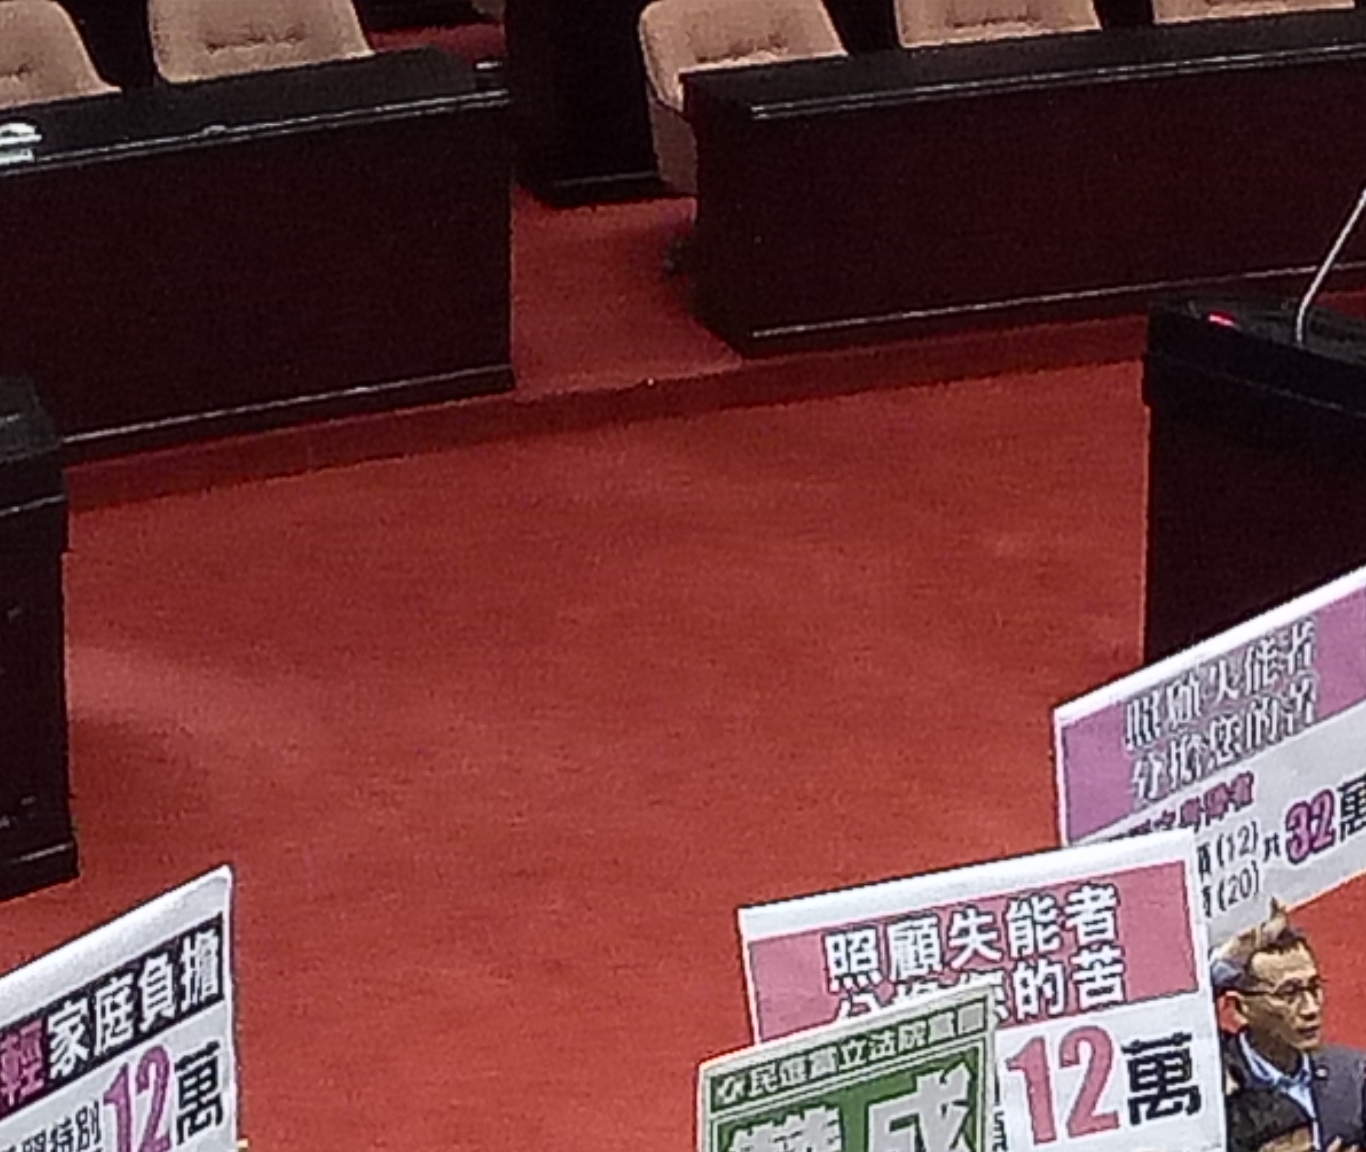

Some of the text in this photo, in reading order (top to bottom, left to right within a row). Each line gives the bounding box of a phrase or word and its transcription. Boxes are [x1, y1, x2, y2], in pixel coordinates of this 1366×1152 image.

[825, 883, 1118, 991] 照顧失能者
[1005, 1026, 1202, 1146] 12萬
